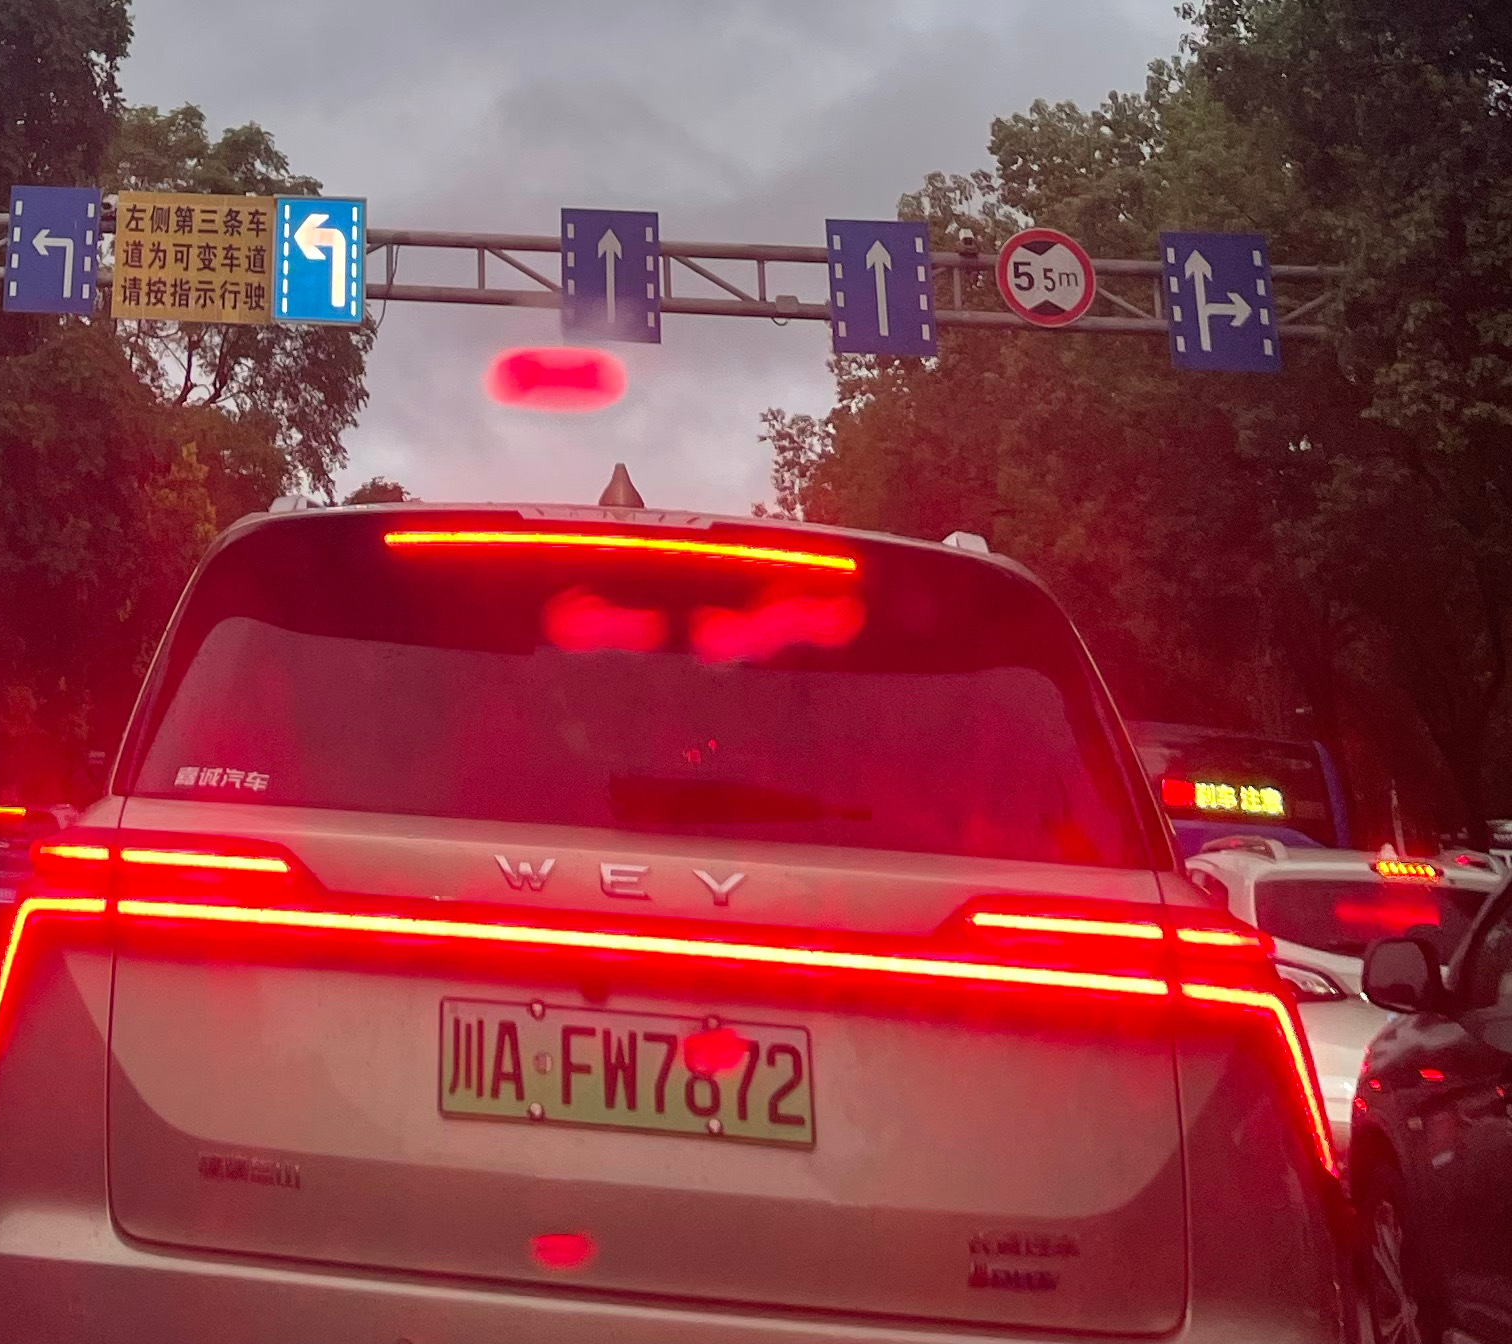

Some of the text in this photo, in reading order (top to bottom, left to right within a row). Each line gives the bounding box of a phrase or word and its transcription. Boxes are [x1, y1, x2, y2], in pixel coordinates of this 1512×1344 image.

[125, 204, 268, 238] 左侧第三条车
[122, 240, 267, 274] 道为可变车道
[121, 276, 266, 311] 请按指示行驶
[494, 854, 745, 907] WEY
